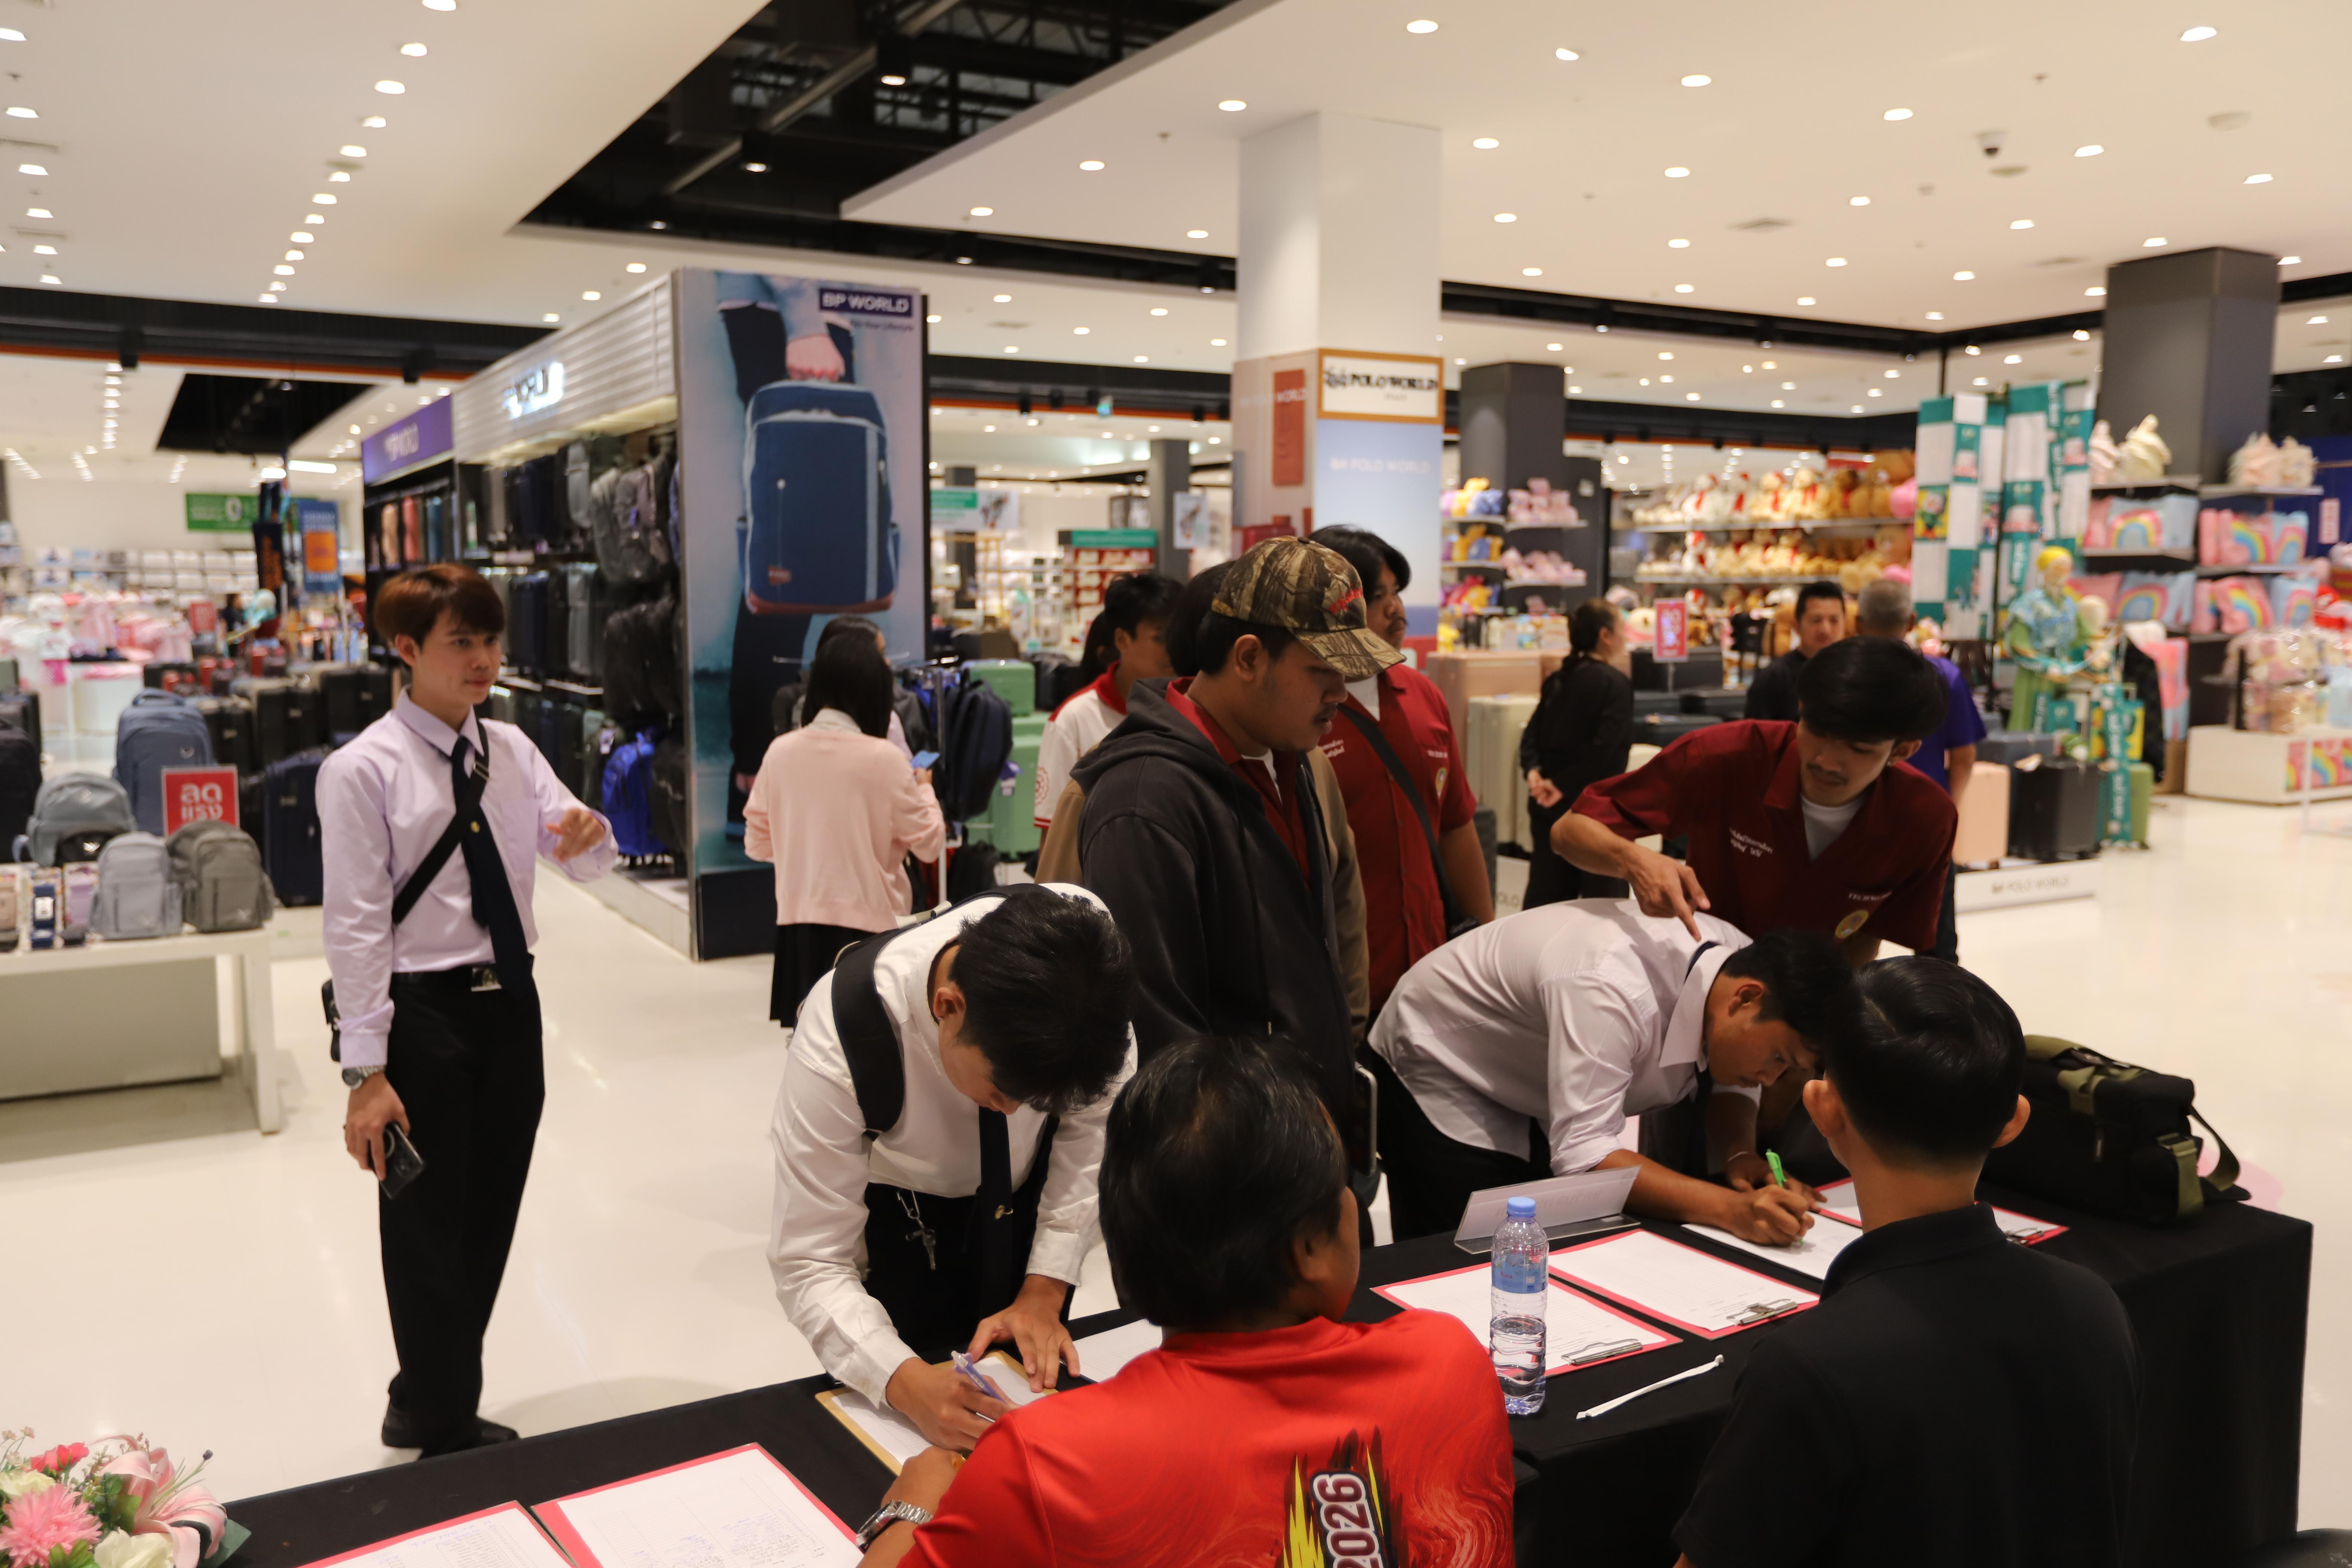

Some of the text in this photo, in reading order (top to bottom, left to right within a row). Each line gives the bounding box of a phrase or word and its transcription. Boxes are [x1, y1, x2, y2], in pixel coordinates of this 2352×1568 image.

[822, 292, 910, 313] BP WORLD
[1389, 376, 1439, 390] WORLD
[181, 782, 223, 804] ลด
